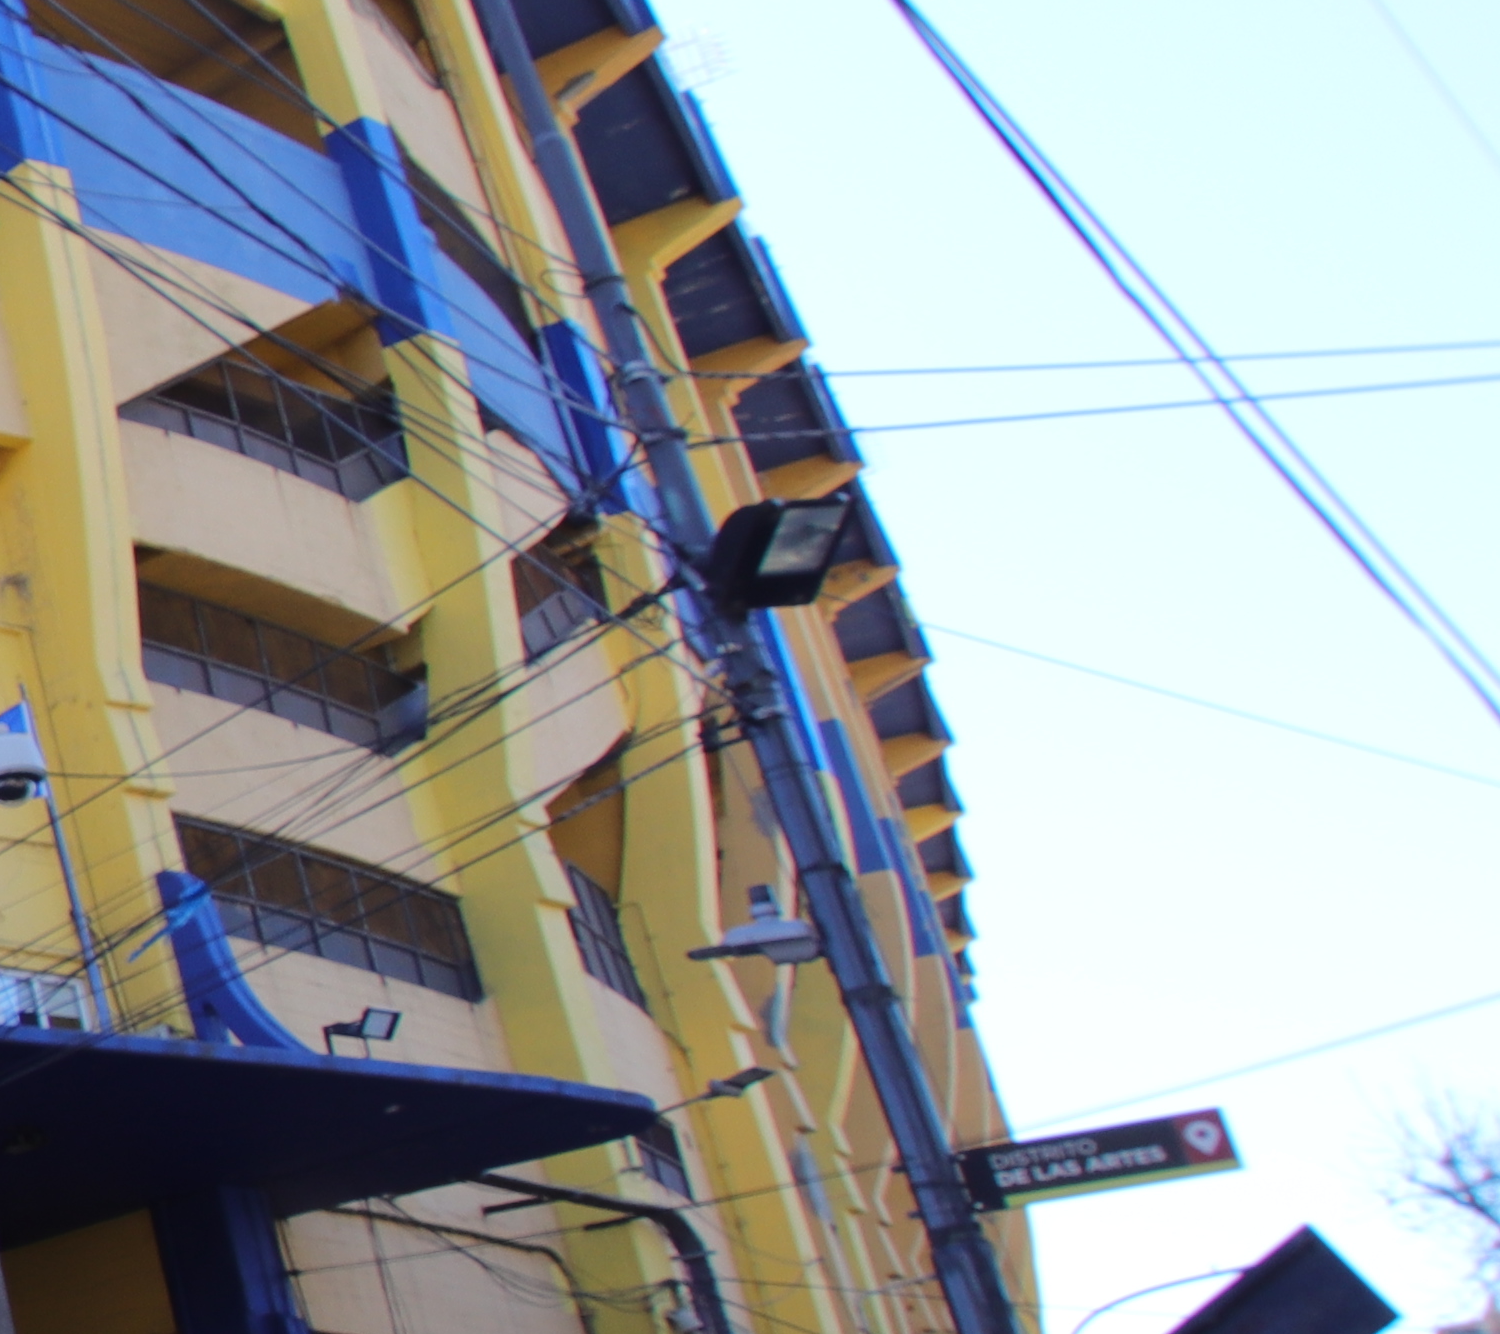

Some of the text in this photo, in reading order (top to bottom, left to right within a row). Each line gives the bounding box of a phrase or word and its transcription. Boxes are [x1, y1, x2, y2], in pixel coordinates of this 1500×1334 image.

[993, 1144, 1169, 1188] DE LAS ARTES
